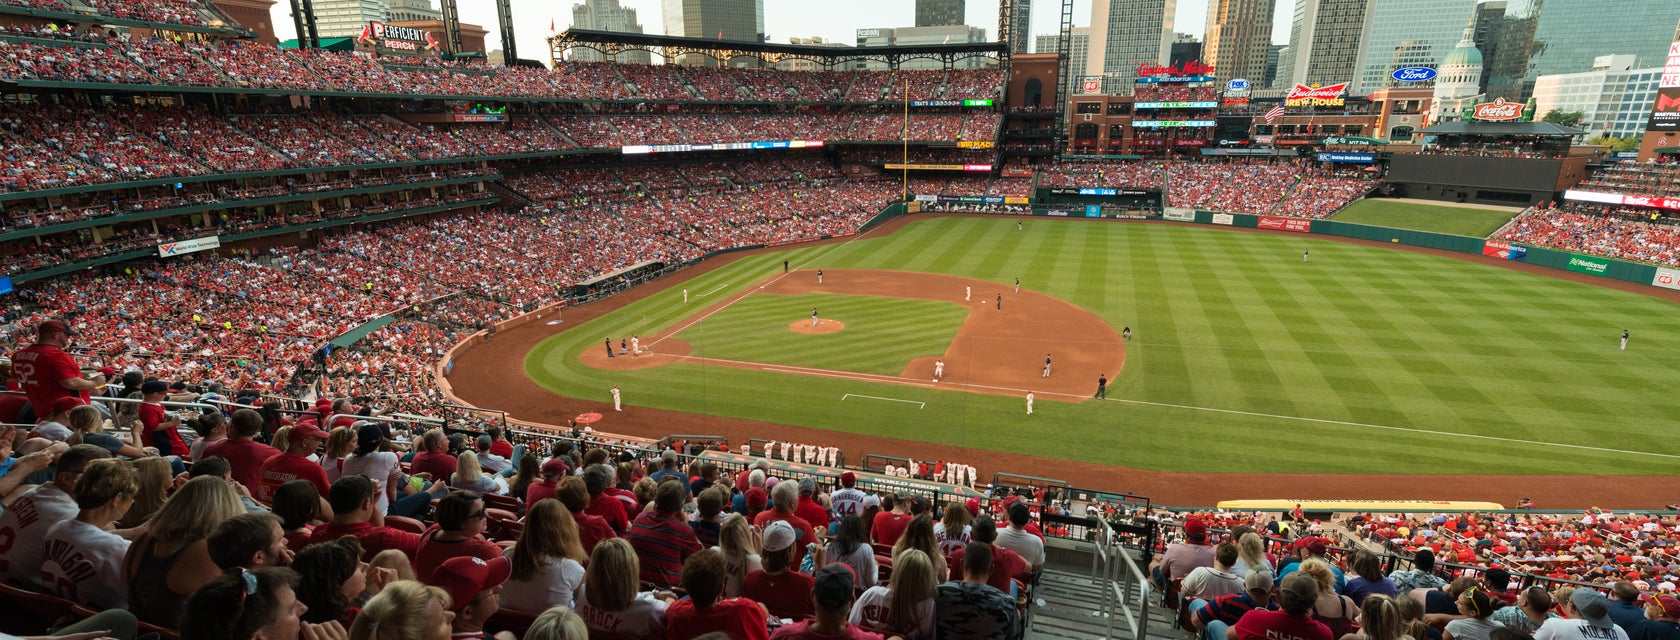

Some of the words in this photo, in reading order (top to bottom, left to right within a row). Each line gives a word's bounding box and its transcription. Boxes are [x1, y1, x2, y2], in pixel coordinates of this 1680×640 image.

[371, 21, 423, 41] PERFICIENT
[385, 40, 415, 50] PERCH
[1138, 61, 1179, 77] Cardinals
[1179, 59, 1215, 76] Nation
[1400, 68, 1429, 80] Ford
[1086, 81, 1098, 89] 66
[1231, 82, 1245, 90] FOX
[1286, 86, 1346, 98] Budweiser
[1311, 98, 1344, 107] HOUSE
[1478, 104, 1517, 118] Coca-Cola
[1485, 240, 1499, 249] Bank
[1505, 244, 1527, 253] America
[1577, 259, 1608, 270] National
[1660, 275, 1672, 283] 66
[14, 362, 36, 384] 52
[873, 477, 908, 486] WORLD
[908, 482, 941, 491] SERIES
[837, 501, 857, 518] 44
[582, 605, 622, 634] BROCK
[1577, 624, 1619, 640] MOLINA
